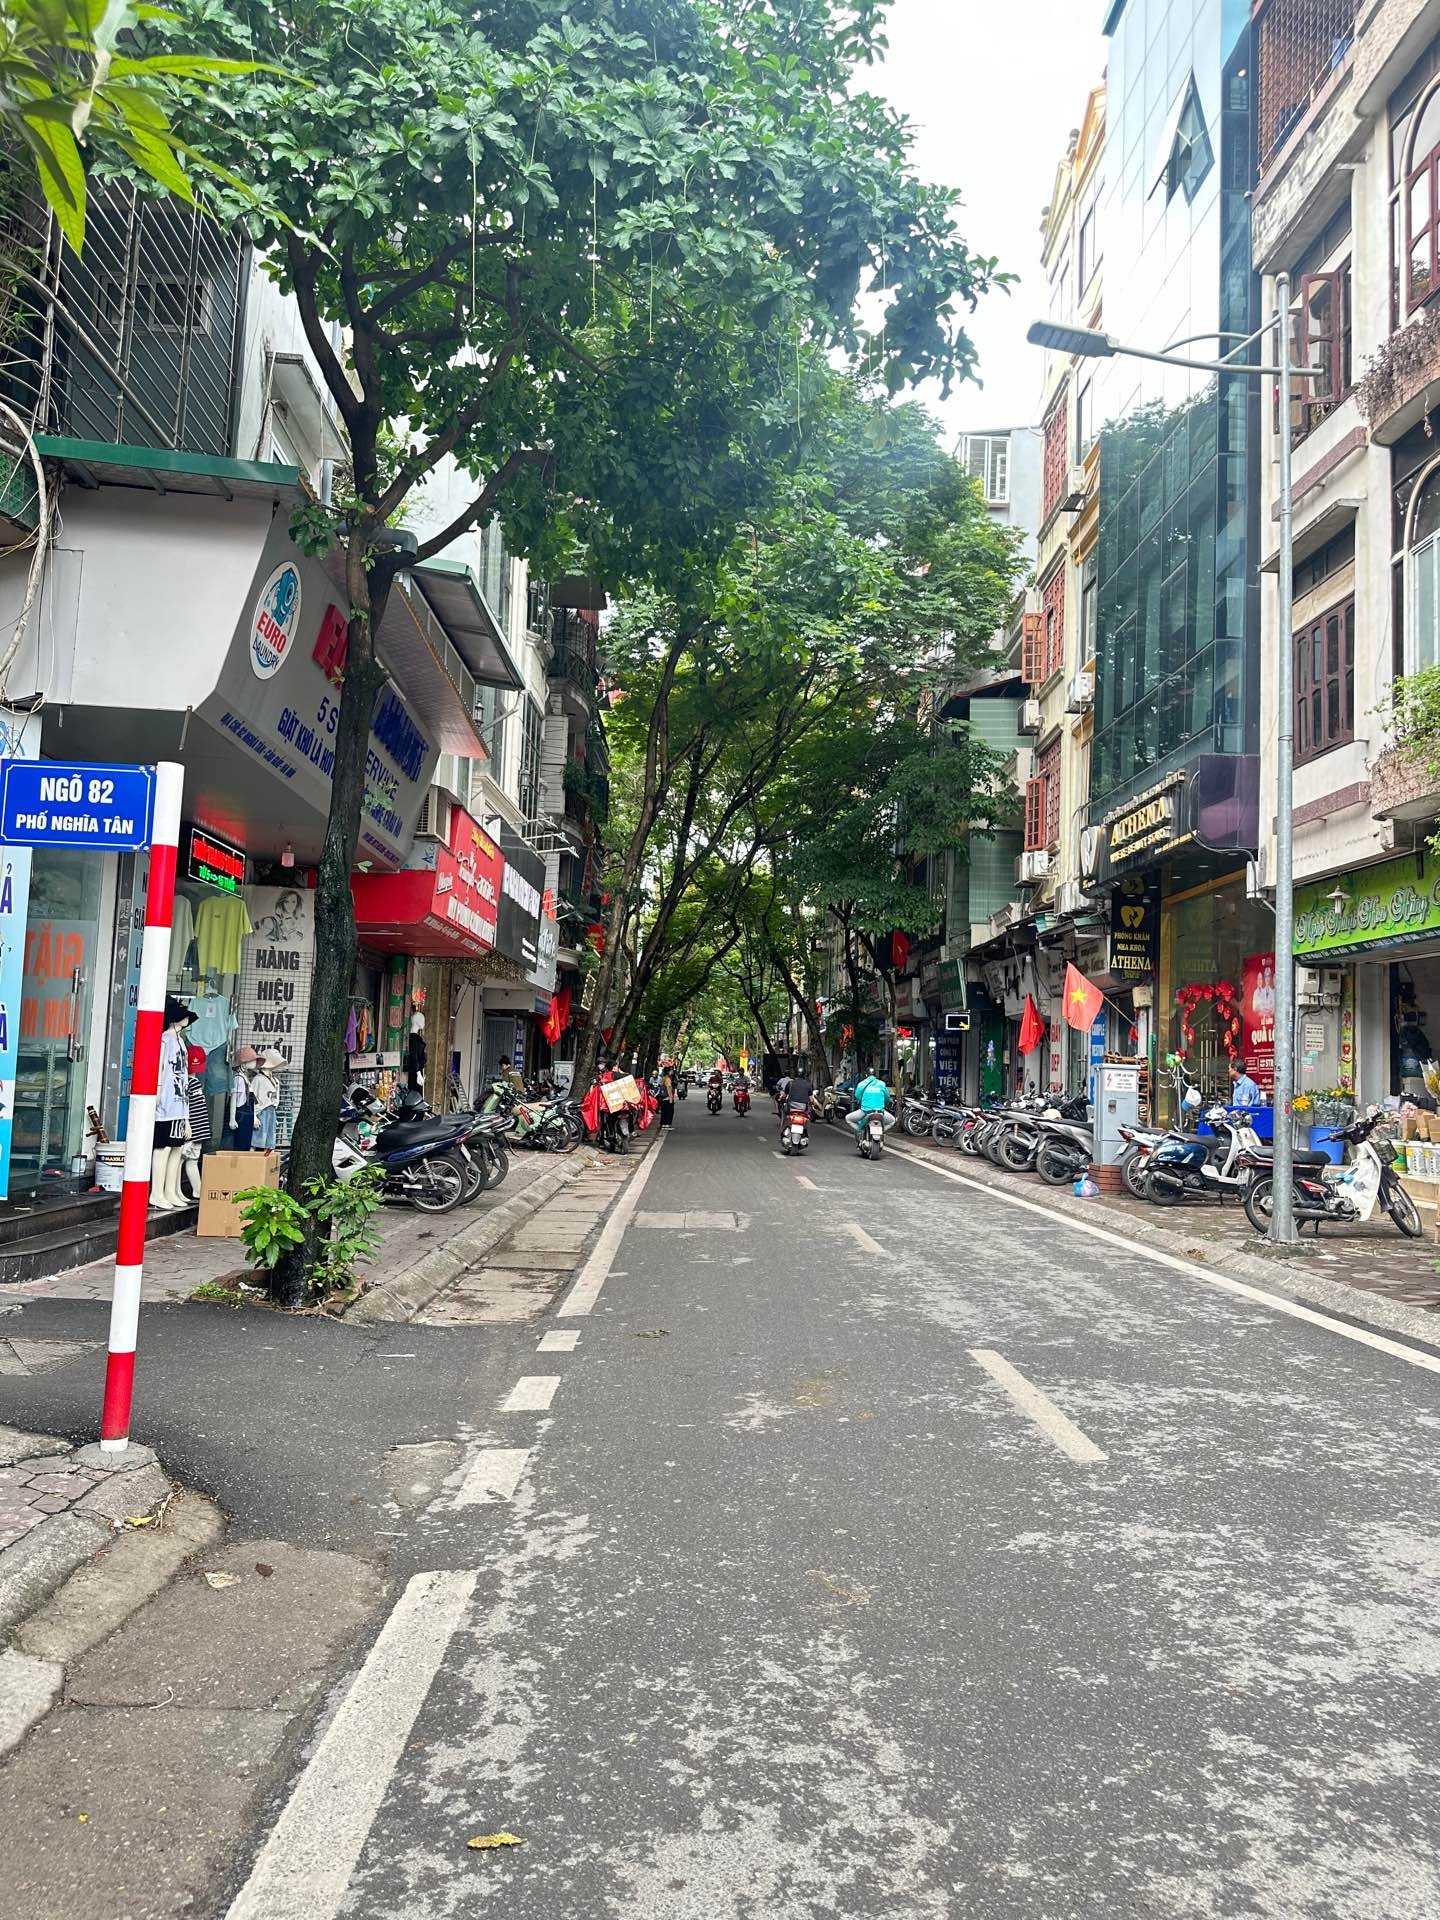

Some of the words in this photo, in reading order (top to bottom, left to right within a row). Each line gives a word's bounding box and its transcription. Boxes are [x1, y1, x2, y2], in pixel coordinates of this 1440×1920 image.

[257, 611, 287, 653] EURO
[252, 640, 280, 670] LAUNDRY
[317, 696, 329, 722] 5
[278, 707, 299, 744] GIẶT
[364, 749, 400, 800] ERVICE
[40, 774, 82, 802] NGÕ
[88, 780, 114, 804] 82
[16, 810, 48, 830] PHỐ
[51, 814, 99, 833] NGHĨA
[103, 816, 134, 834] TÂN
[1110, 796, 1171, 847] ATHENA
[255, 946, 300, 971] HÀNG
[1111, 955, 1151, 970] ATHENA
[257, 978, 295, 1005] HIỆU
[252, 1007, 294, 1033] XUẤT
[939, 1059, 958, 1072] VIỆT
[938, 1073, 958, 1087] TIẾN
